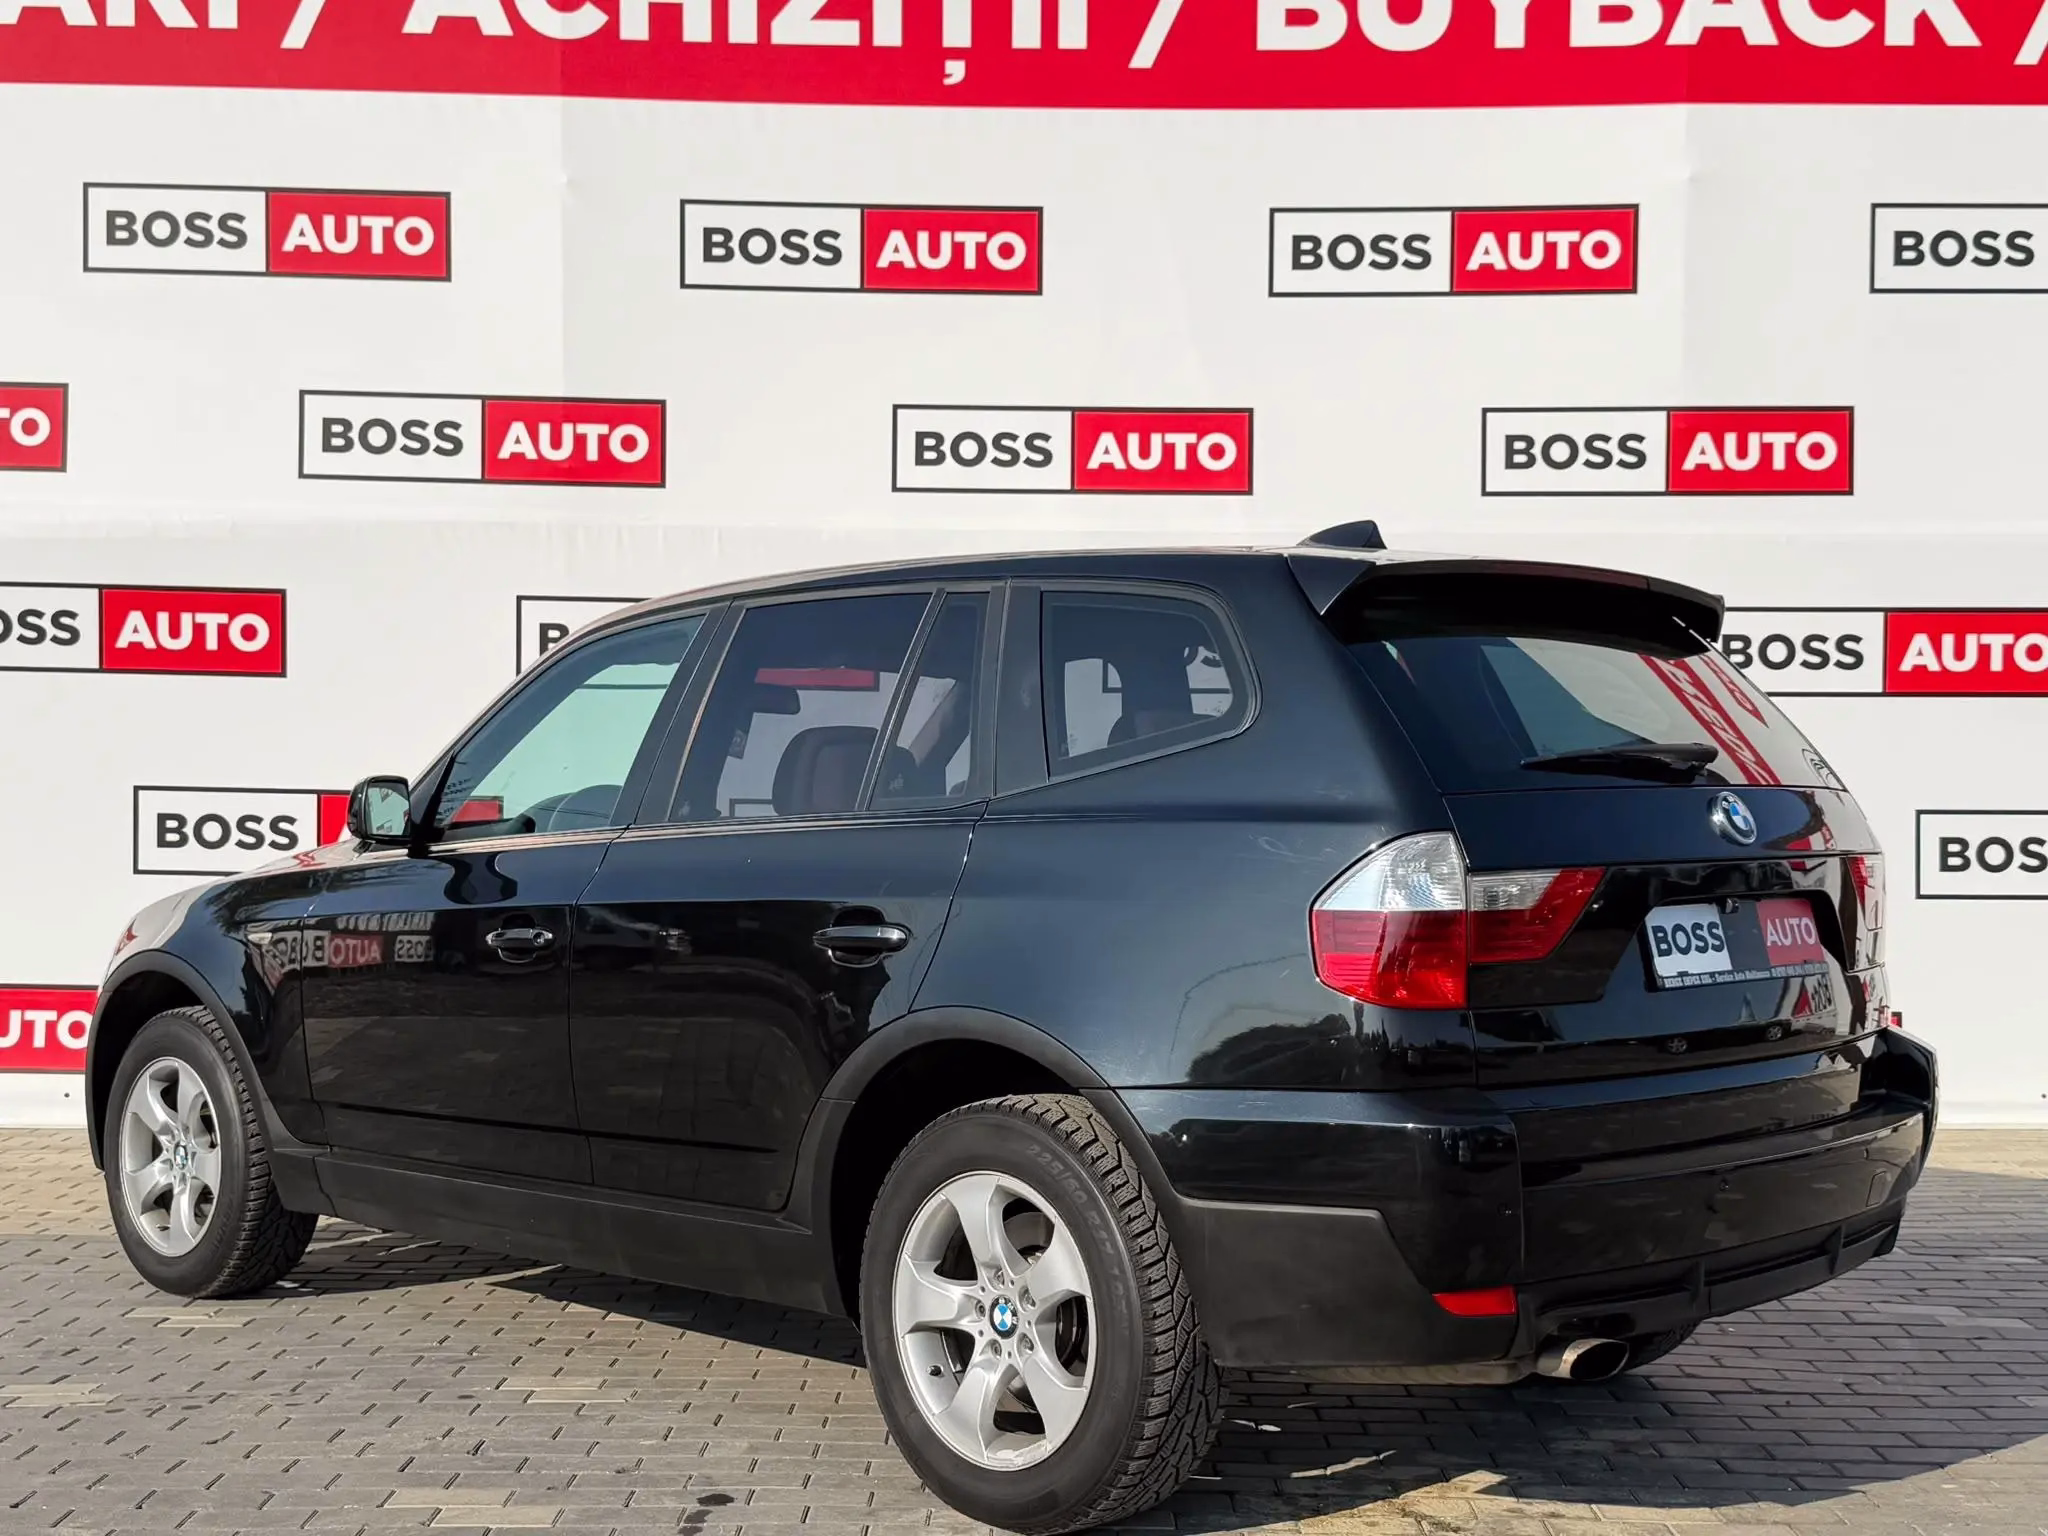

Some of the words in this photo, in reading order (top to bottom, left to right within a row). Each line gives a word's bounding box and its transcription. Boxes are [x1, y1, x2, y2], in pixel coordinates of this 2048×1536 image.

[107, 210, 248, 249] BOSS
[283, 214, 435, 256] AUTO
[703, 227, 842, 266] BOSS
[877, 231, 1027, 271] AUTO
[1292, 233, 1432, 271] BOSS
[1467, 230, 1621, 271] AUTO
[1894, 229, 2035, 267] BOSS
[0, 407, 51, 447] O
[322, 417, 464, 457] BOSS
[498, 421, 650, 463] AUTO
[915, 431, 1053, 468] BOSS
[1088, 432, 1237, 471] AUTO
[1505, 433, 1647, 470] BOSS
[1683, 431, 1838, 471] AUTO
[115, 611, 270, 652] AUTO
[1722, 633, 1864, 671] BOSS
[1899, 633, 2048, 673] AUTO
[157, 812, 299, 852] BOSS
[1938, 836, 2048, 874] BOS
[1650, 920, 1725, 957] BOSS
[1766, 916, 1816, 947] AUTO
